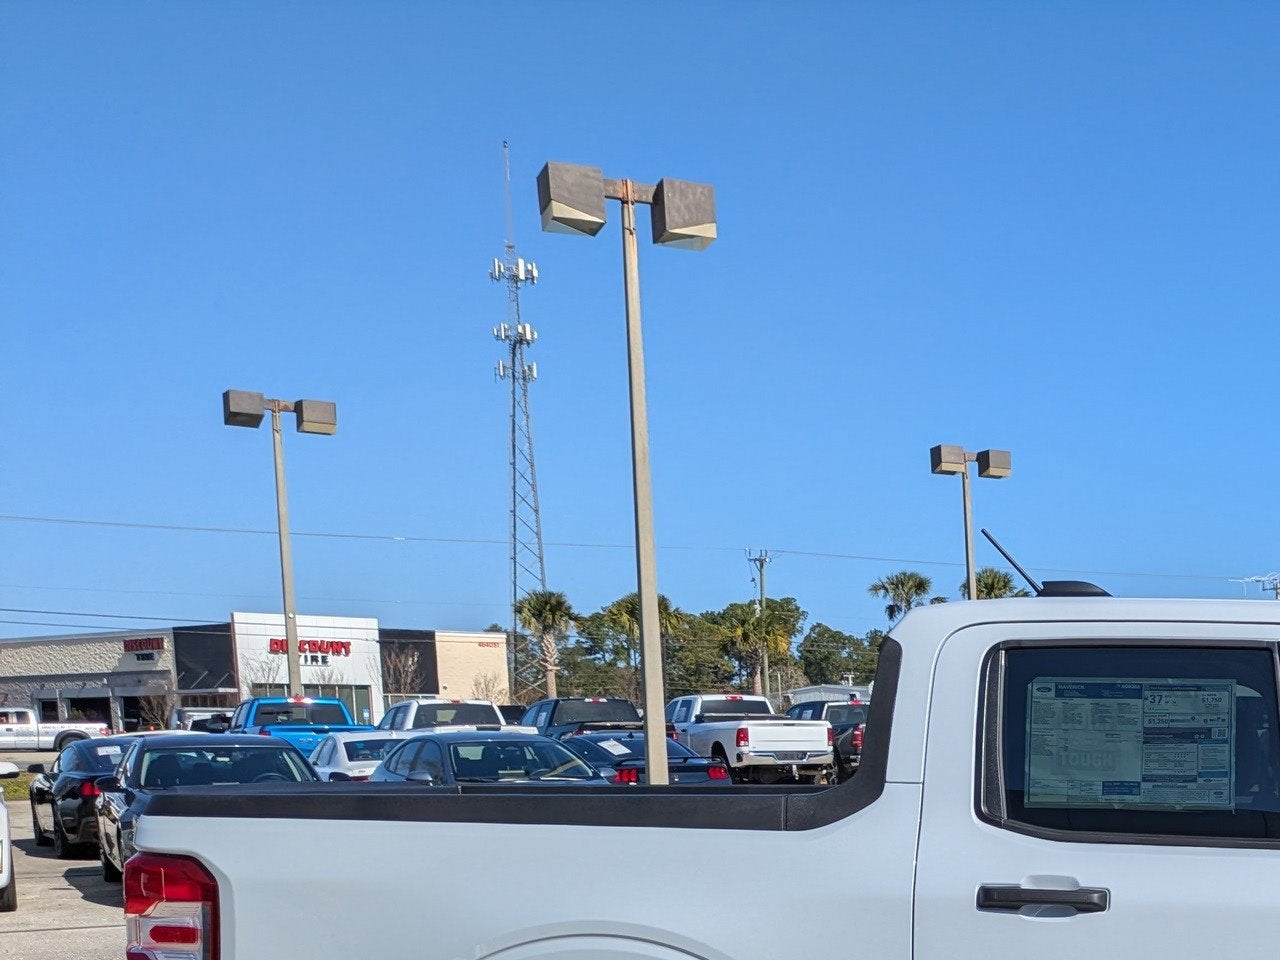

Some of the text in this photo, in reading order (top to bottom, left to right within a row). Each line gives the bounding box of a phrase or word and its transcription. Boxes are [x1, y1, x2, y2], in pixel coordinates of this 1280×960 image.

[269, 638, 352, 657] DICOUNT
[299, 654, 329, 665] IRE
[1149, 694, 1163, 704] 37
